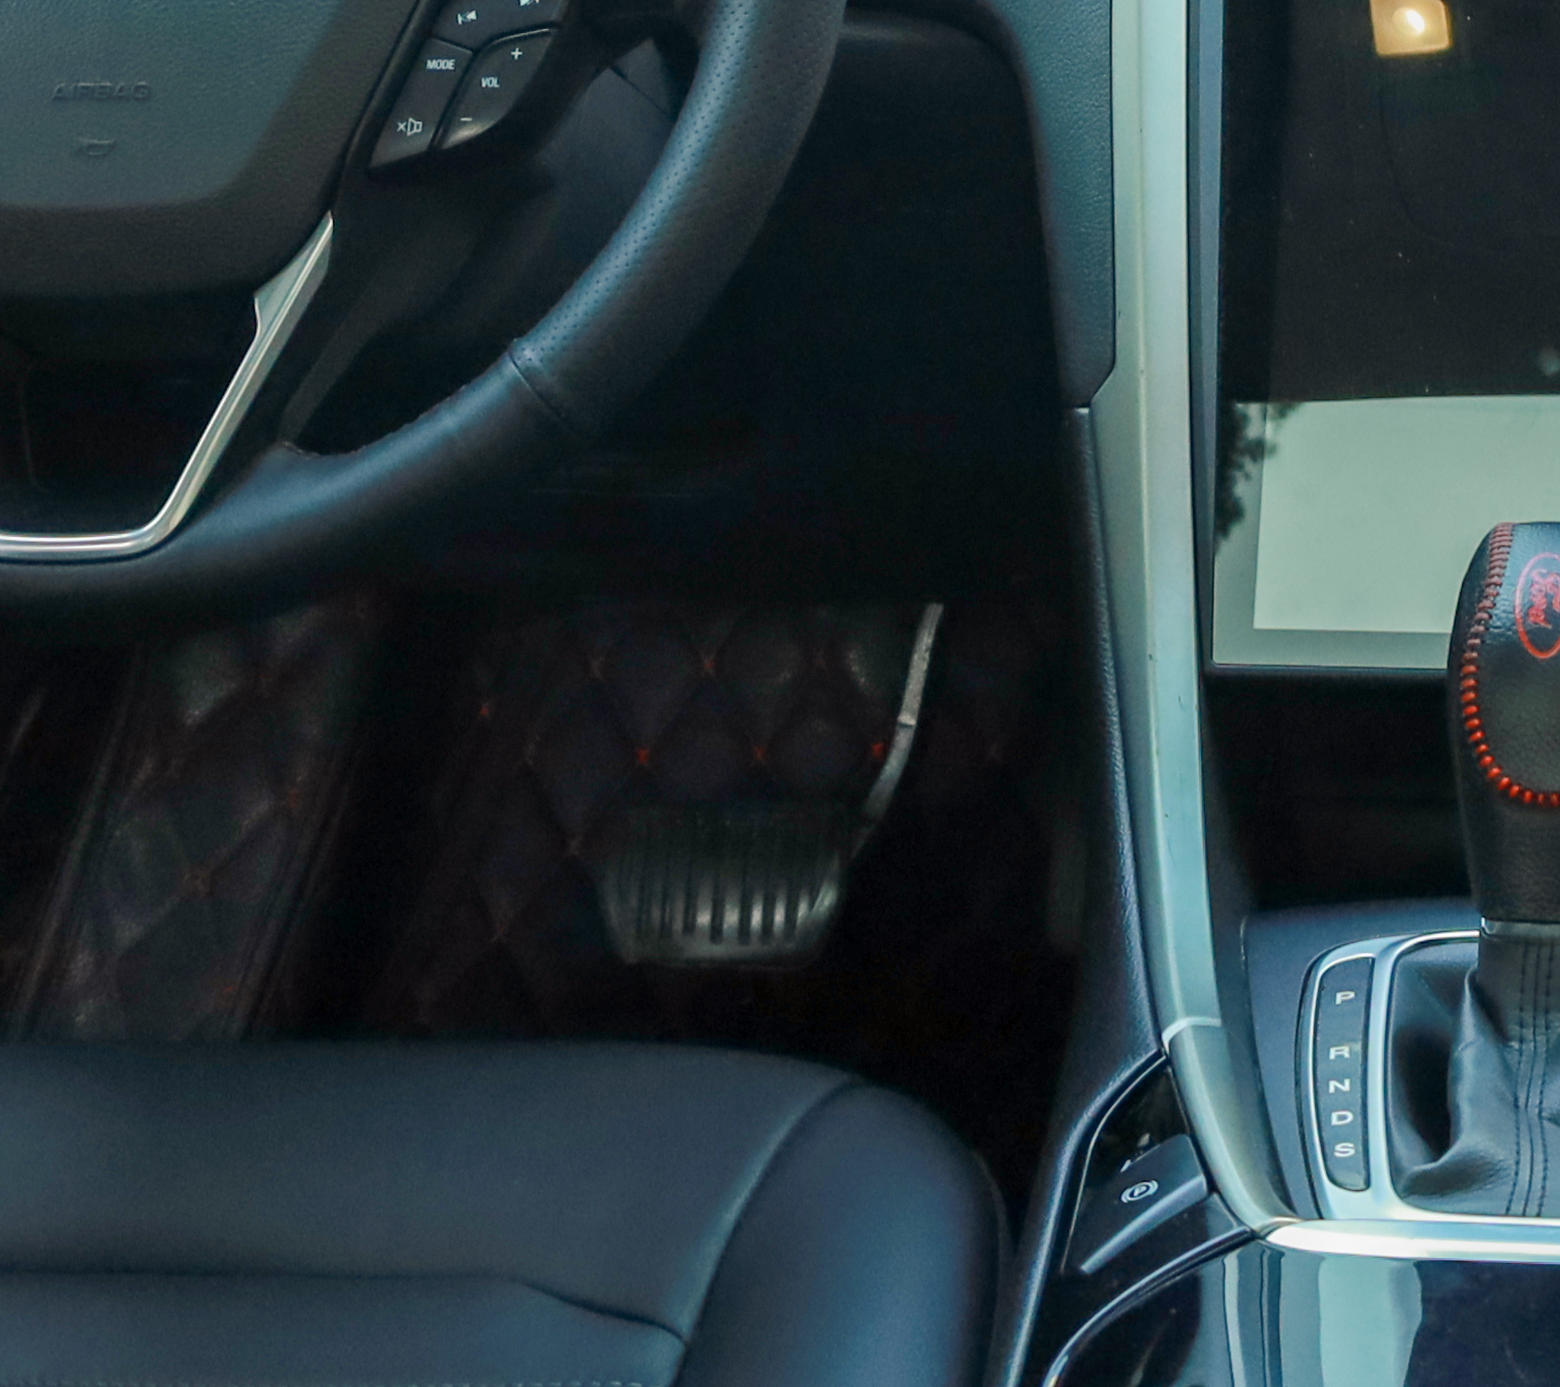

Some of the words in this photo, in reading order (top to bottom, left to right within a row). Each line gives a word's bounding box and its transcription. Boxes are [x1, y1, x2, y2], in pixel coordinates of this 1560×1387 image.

[426, 58, 456, 70] MODE
[481, 77, 500, 88] VOL
[1335, 991, 1356, 1005] P
[1329, 1045, 1351, 1060] R
[1328, 1078, 1351, 1094] N
[1331, 1110, 1354, 1126] D
[1333, 1142, 1356, 1158] S
